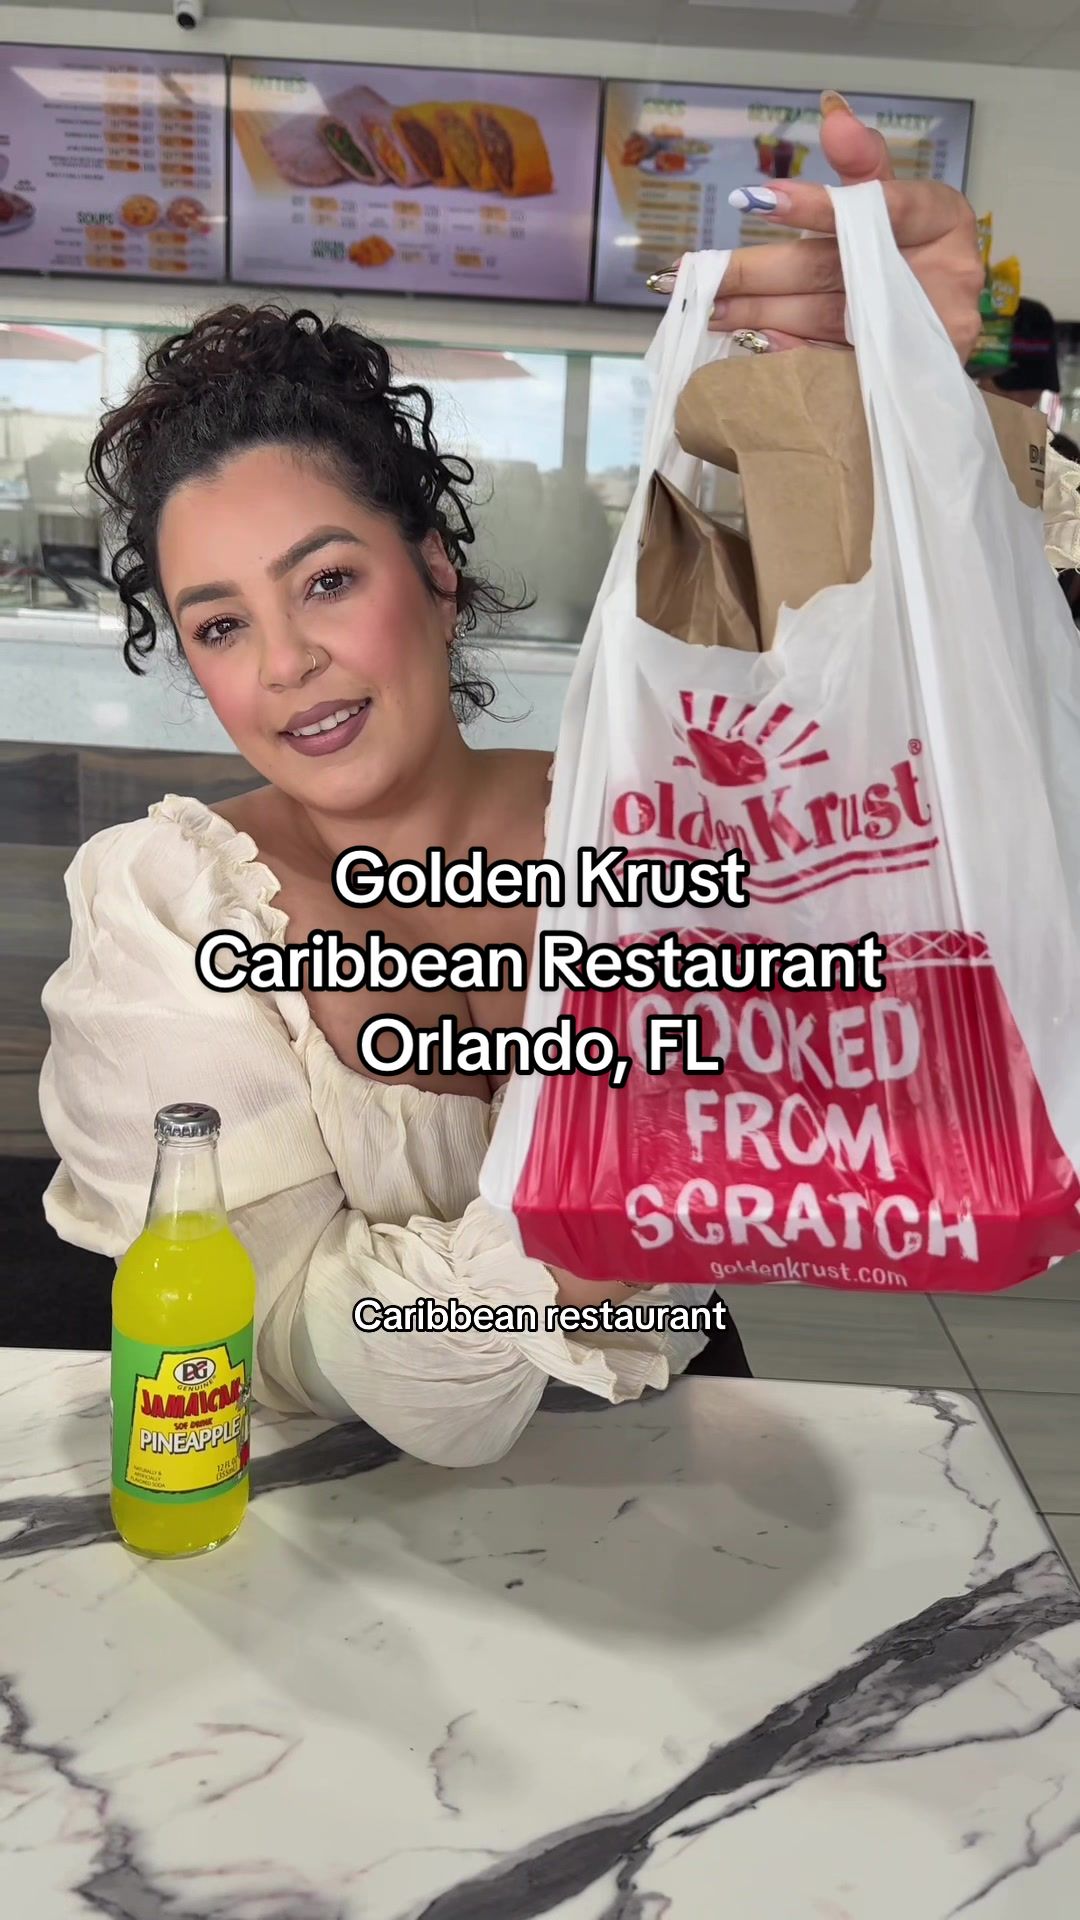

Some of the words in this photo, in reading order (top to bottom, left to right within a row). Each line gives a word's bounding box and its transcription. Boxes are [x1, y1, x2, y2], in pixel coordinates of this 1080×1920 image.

[627, 991, 921, 1089] COOKED
[684, 1089, 896, 1182] FROM
[626, 1178, 979, 1262] SCRATCH
[710, 1256, 909, 1288] goldenkrust.com
[176, 1379, 214, 1392] GENUINE
[140, 1414, 241, 1455] PINEAPPLE
[217, 1463, 224, 1472] 12
